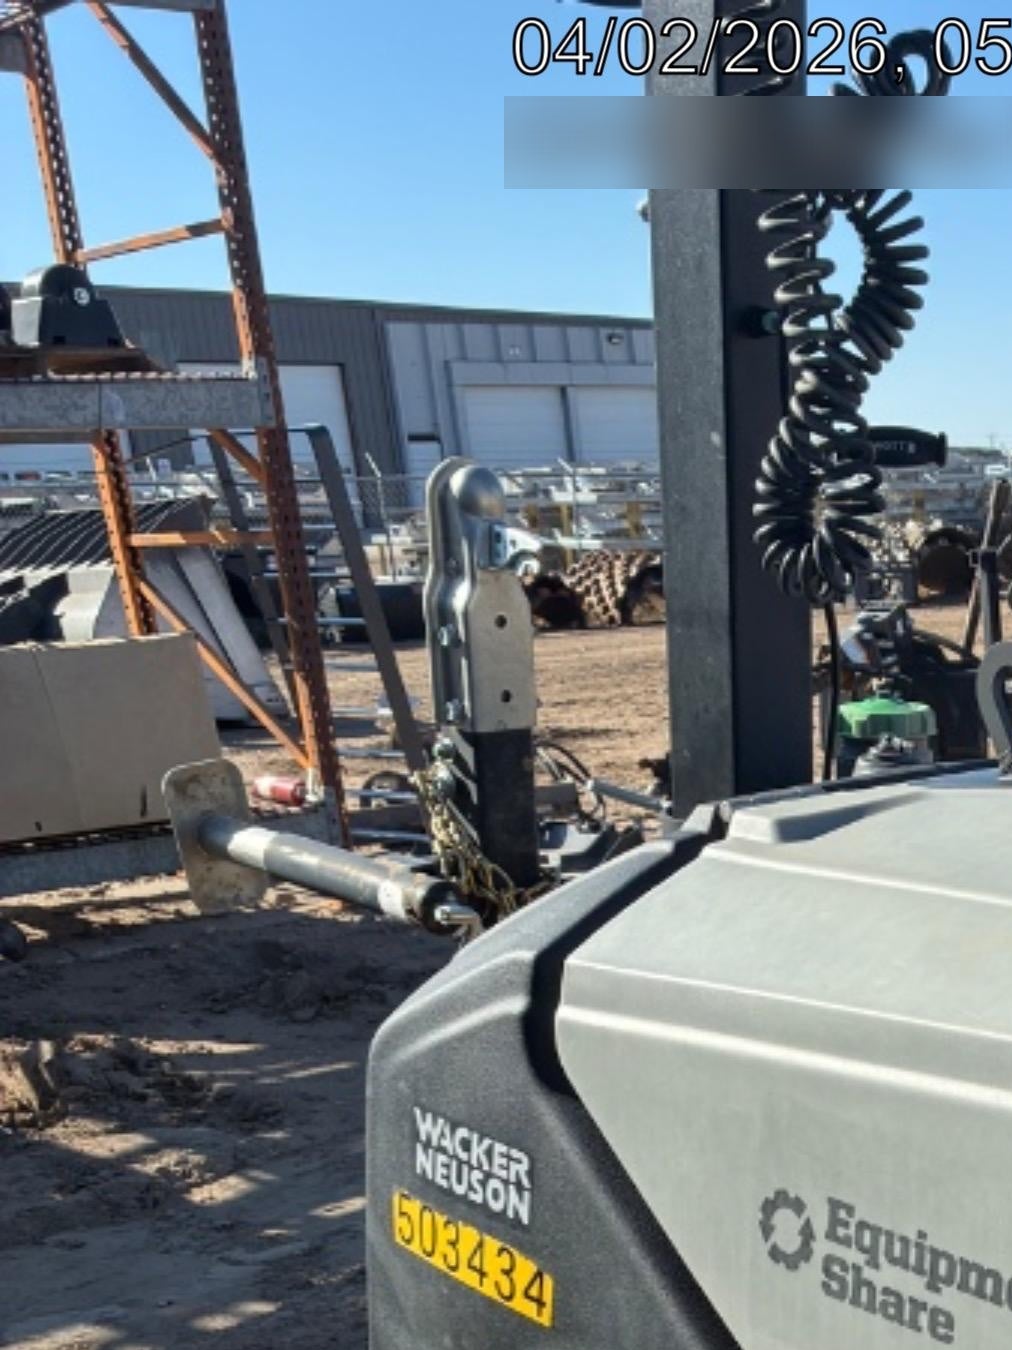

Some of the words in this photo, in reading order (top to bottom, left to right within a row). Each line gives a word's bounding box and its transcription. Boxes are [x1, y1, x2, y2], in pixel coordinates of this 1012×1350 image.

[413, 1106, 532, 1189] WACKER
[415, 1143, 530, 1225] NEUSON
[397, 1193, 547, 1319] 503434
[821, 1253, 955, 1345] Share
